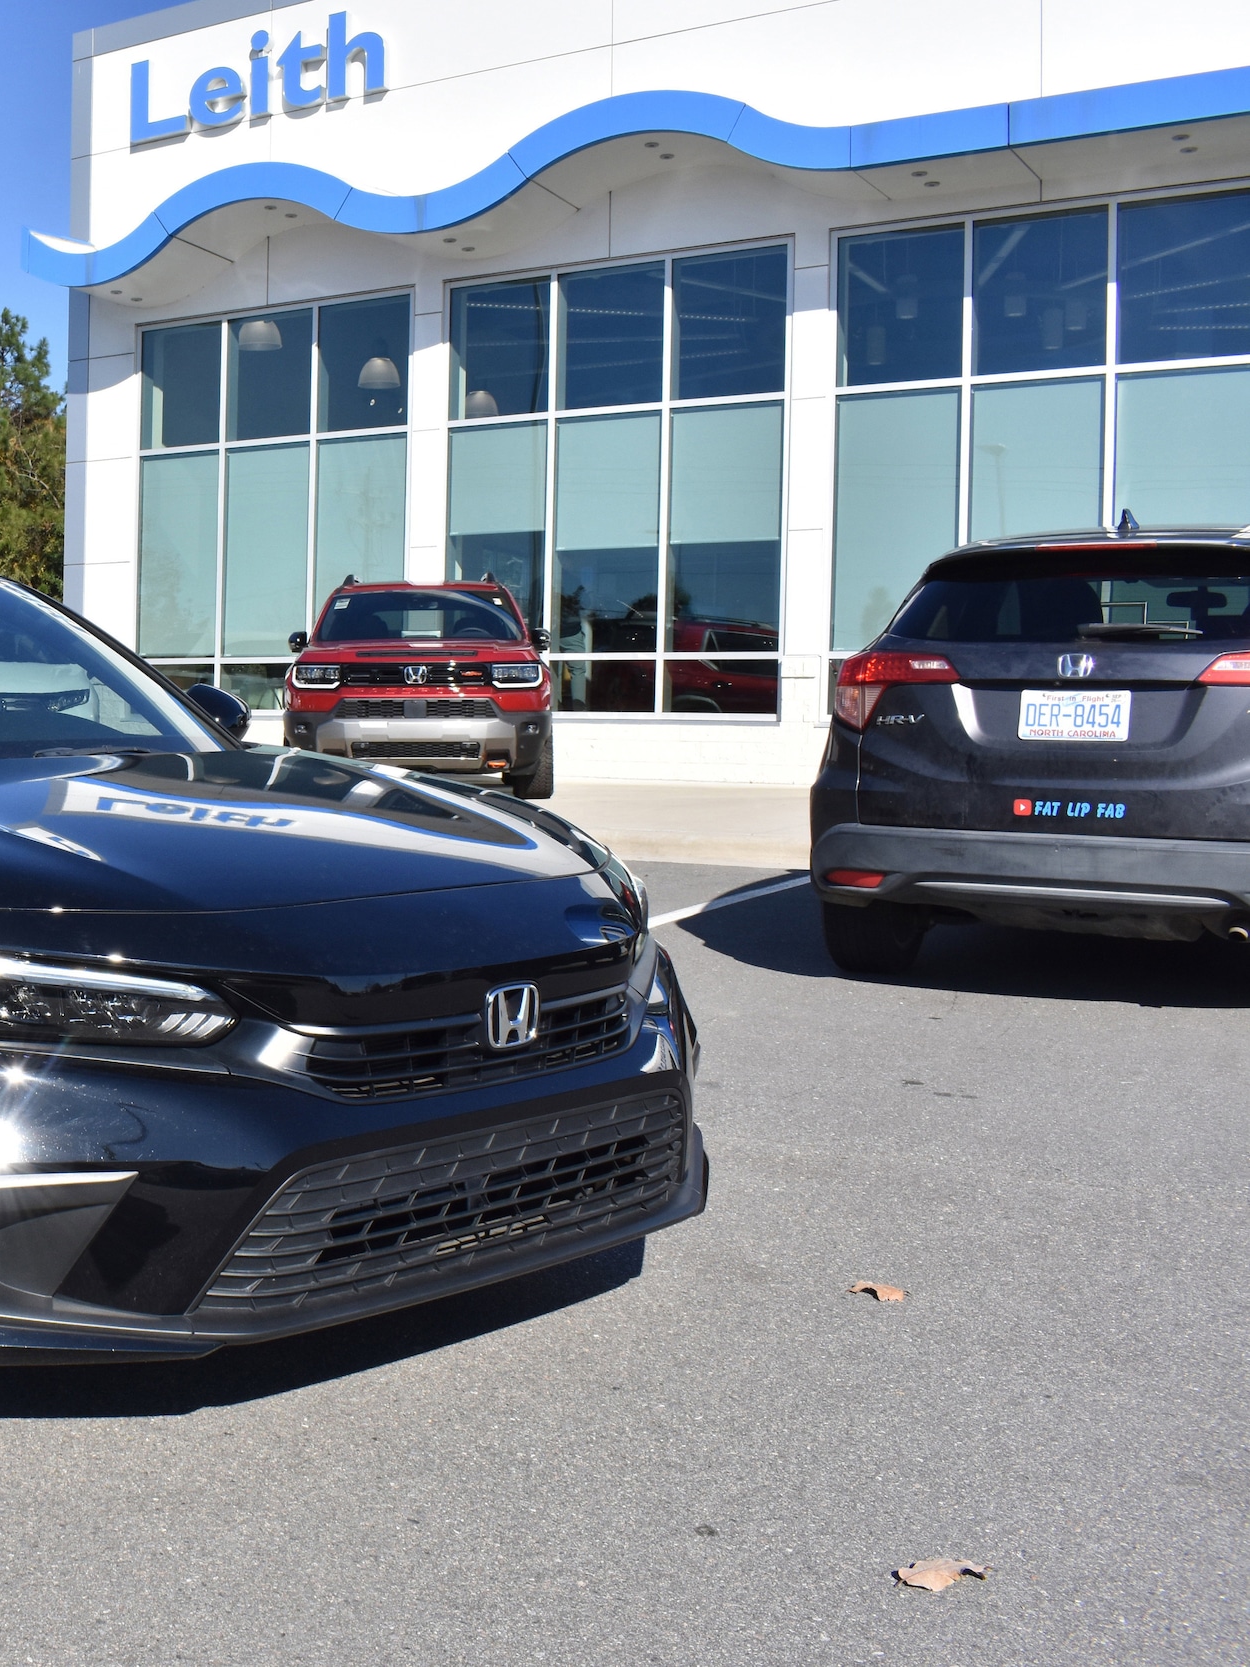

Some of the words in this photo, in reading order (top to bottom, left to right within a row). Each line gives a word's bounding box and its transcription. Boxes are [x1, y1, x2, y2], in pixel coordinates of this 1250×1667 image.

[131, 11, 385, 143] Leith
[1081, 695, 1105, 703] Flight
[876, 714, 925, 725] HR-V
[1025, 703, 1121, 728] DER-8454
[1029, 729, 1064, 737] NORTH
[1067, 730, 1116, 738] CAROLINA
[1034, 801, 1061, 817] FAT
[1066, 802, 1091, 818] LIP
[1096, 803, 1126, 819] FAB
